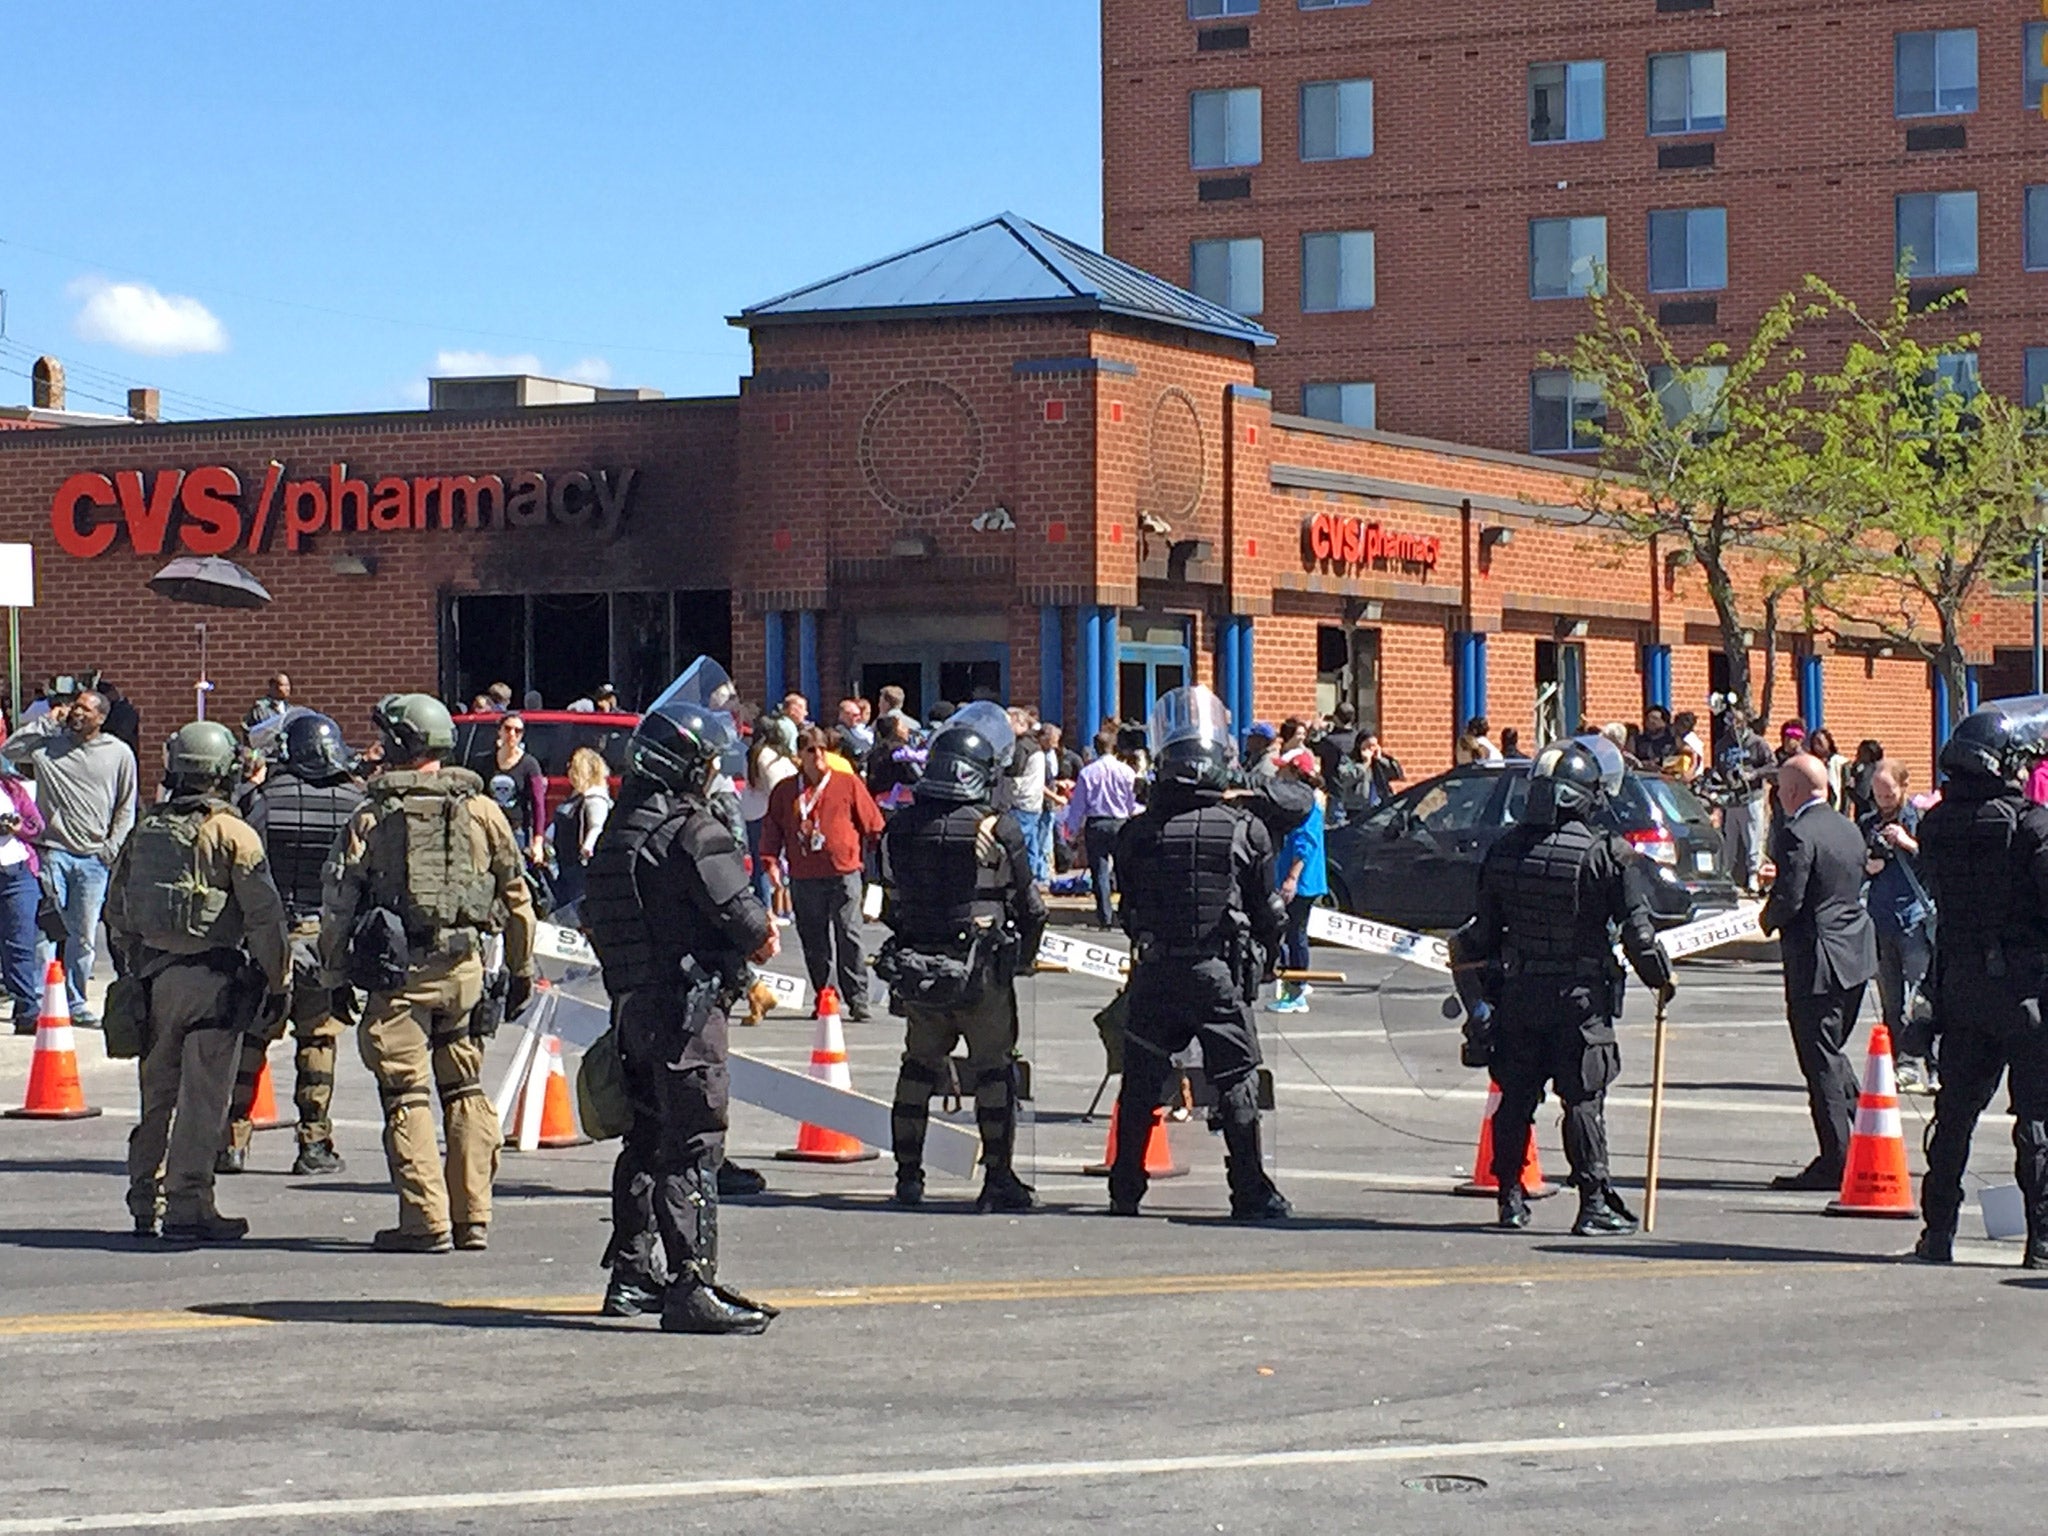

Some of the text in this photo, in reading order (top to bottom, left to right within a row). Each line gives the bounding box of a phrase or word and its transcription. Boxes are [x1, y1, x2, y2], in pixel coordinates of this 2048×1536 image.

[51, 459, 637, 557] CVS/pharmacy
[1311, 512, 1441, 572] CVS/pharmacy
[1328, 915, 1421, 947] STREET
[1675, 918, 1758, 953] STREET
